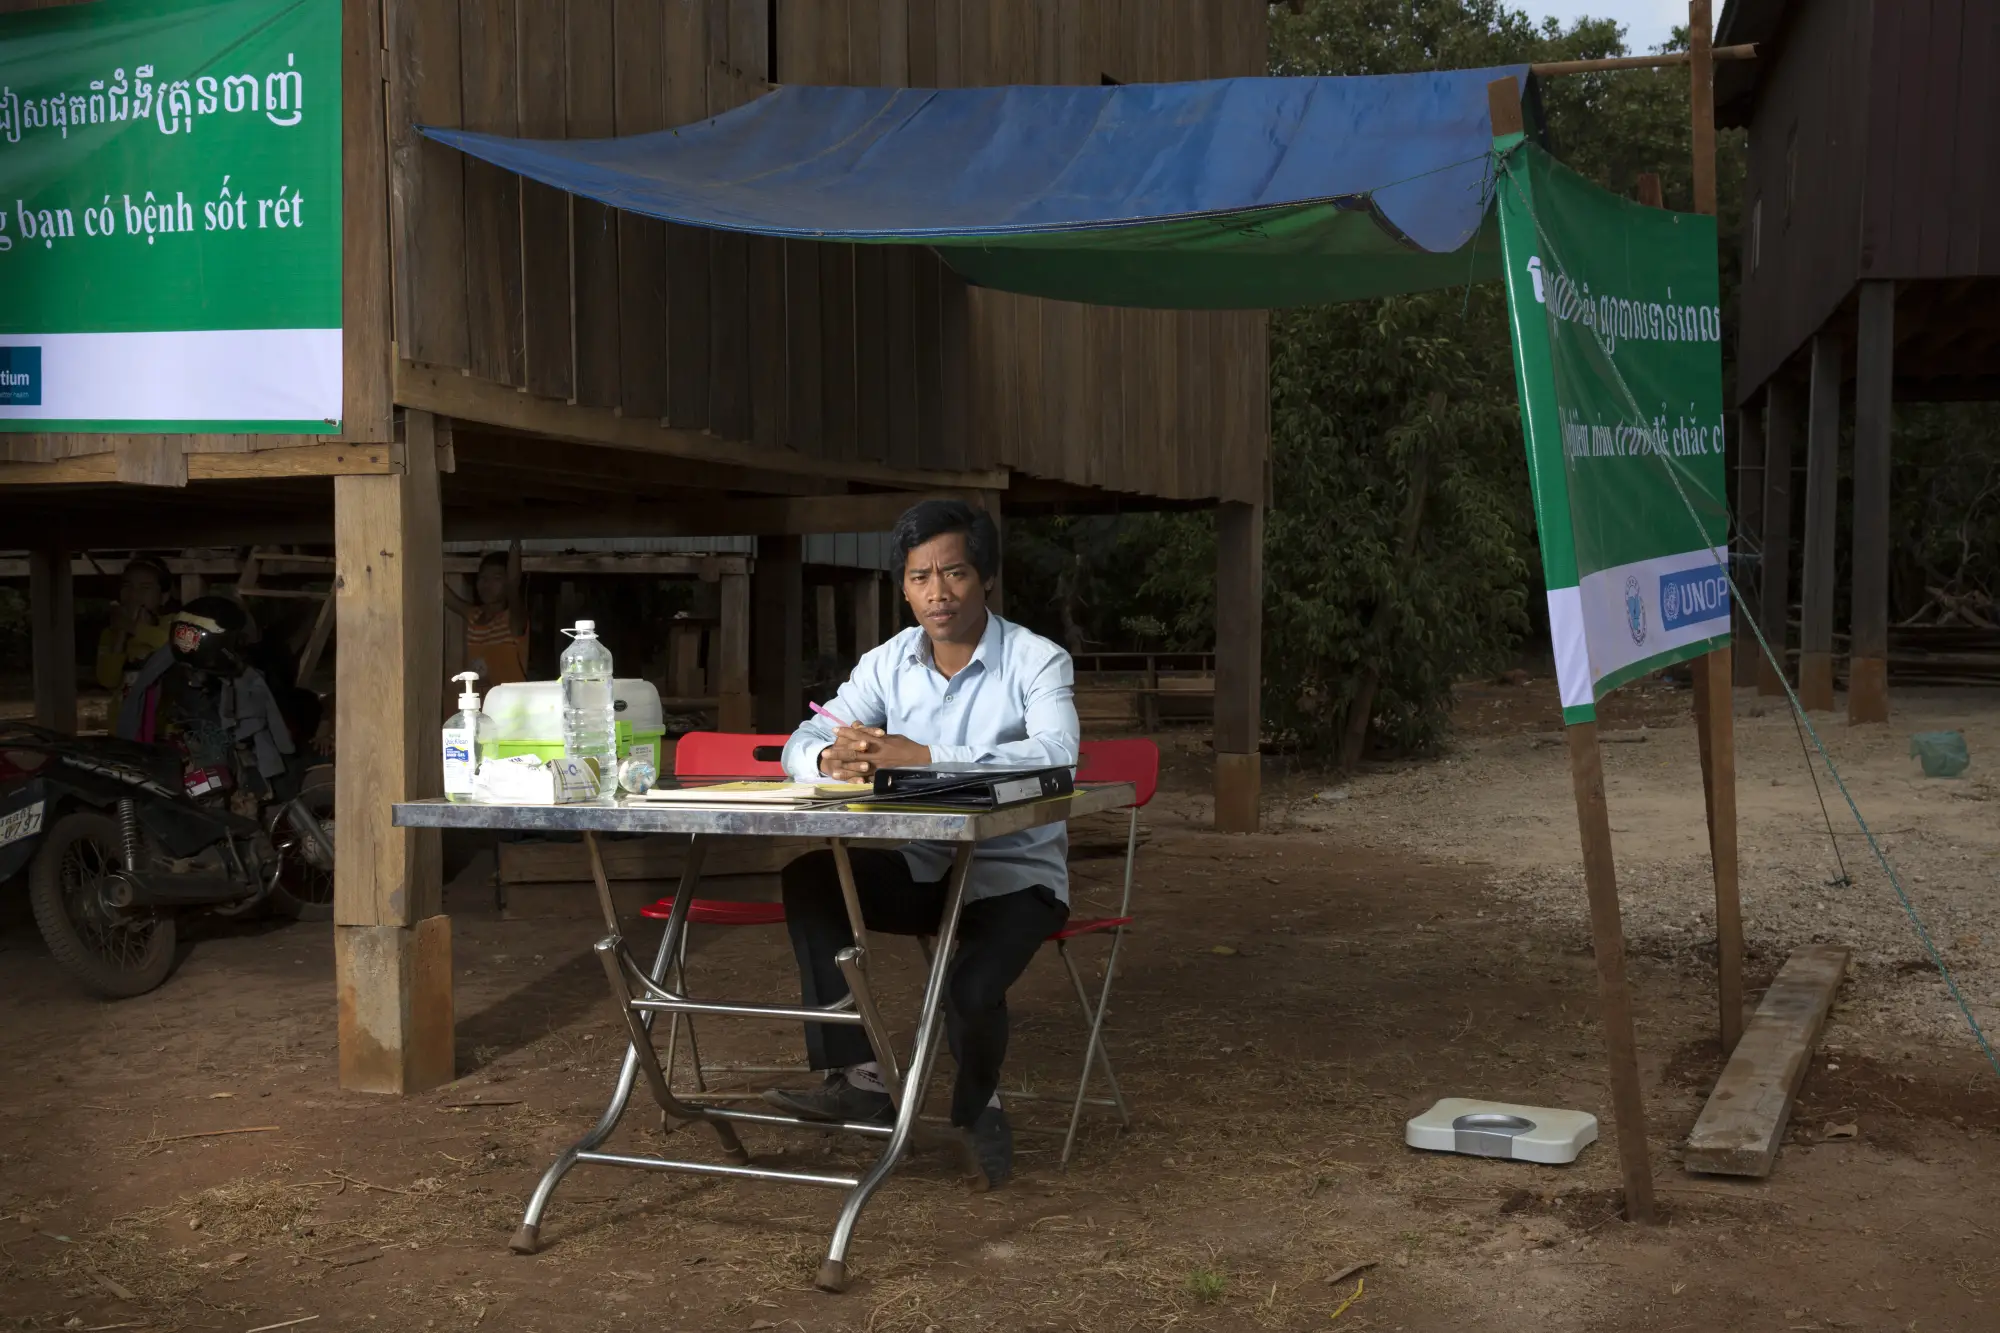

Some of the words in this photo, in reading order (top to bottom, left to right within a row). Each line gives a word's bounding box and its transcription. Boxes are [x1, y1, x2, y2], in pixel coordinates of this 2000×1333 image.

[16, 199, 76, 249] bạn
[84, 194, 115, 236] có
[123, 191, 194, 245] bệnh
[204, 175, 247, 231] sốt
[257, 186, 303, 228] rét
[0, 369, 30, 386] tium
[1673, 402, 1709, 457] chắc
[1680, 577, 1729, 616] UNOP
